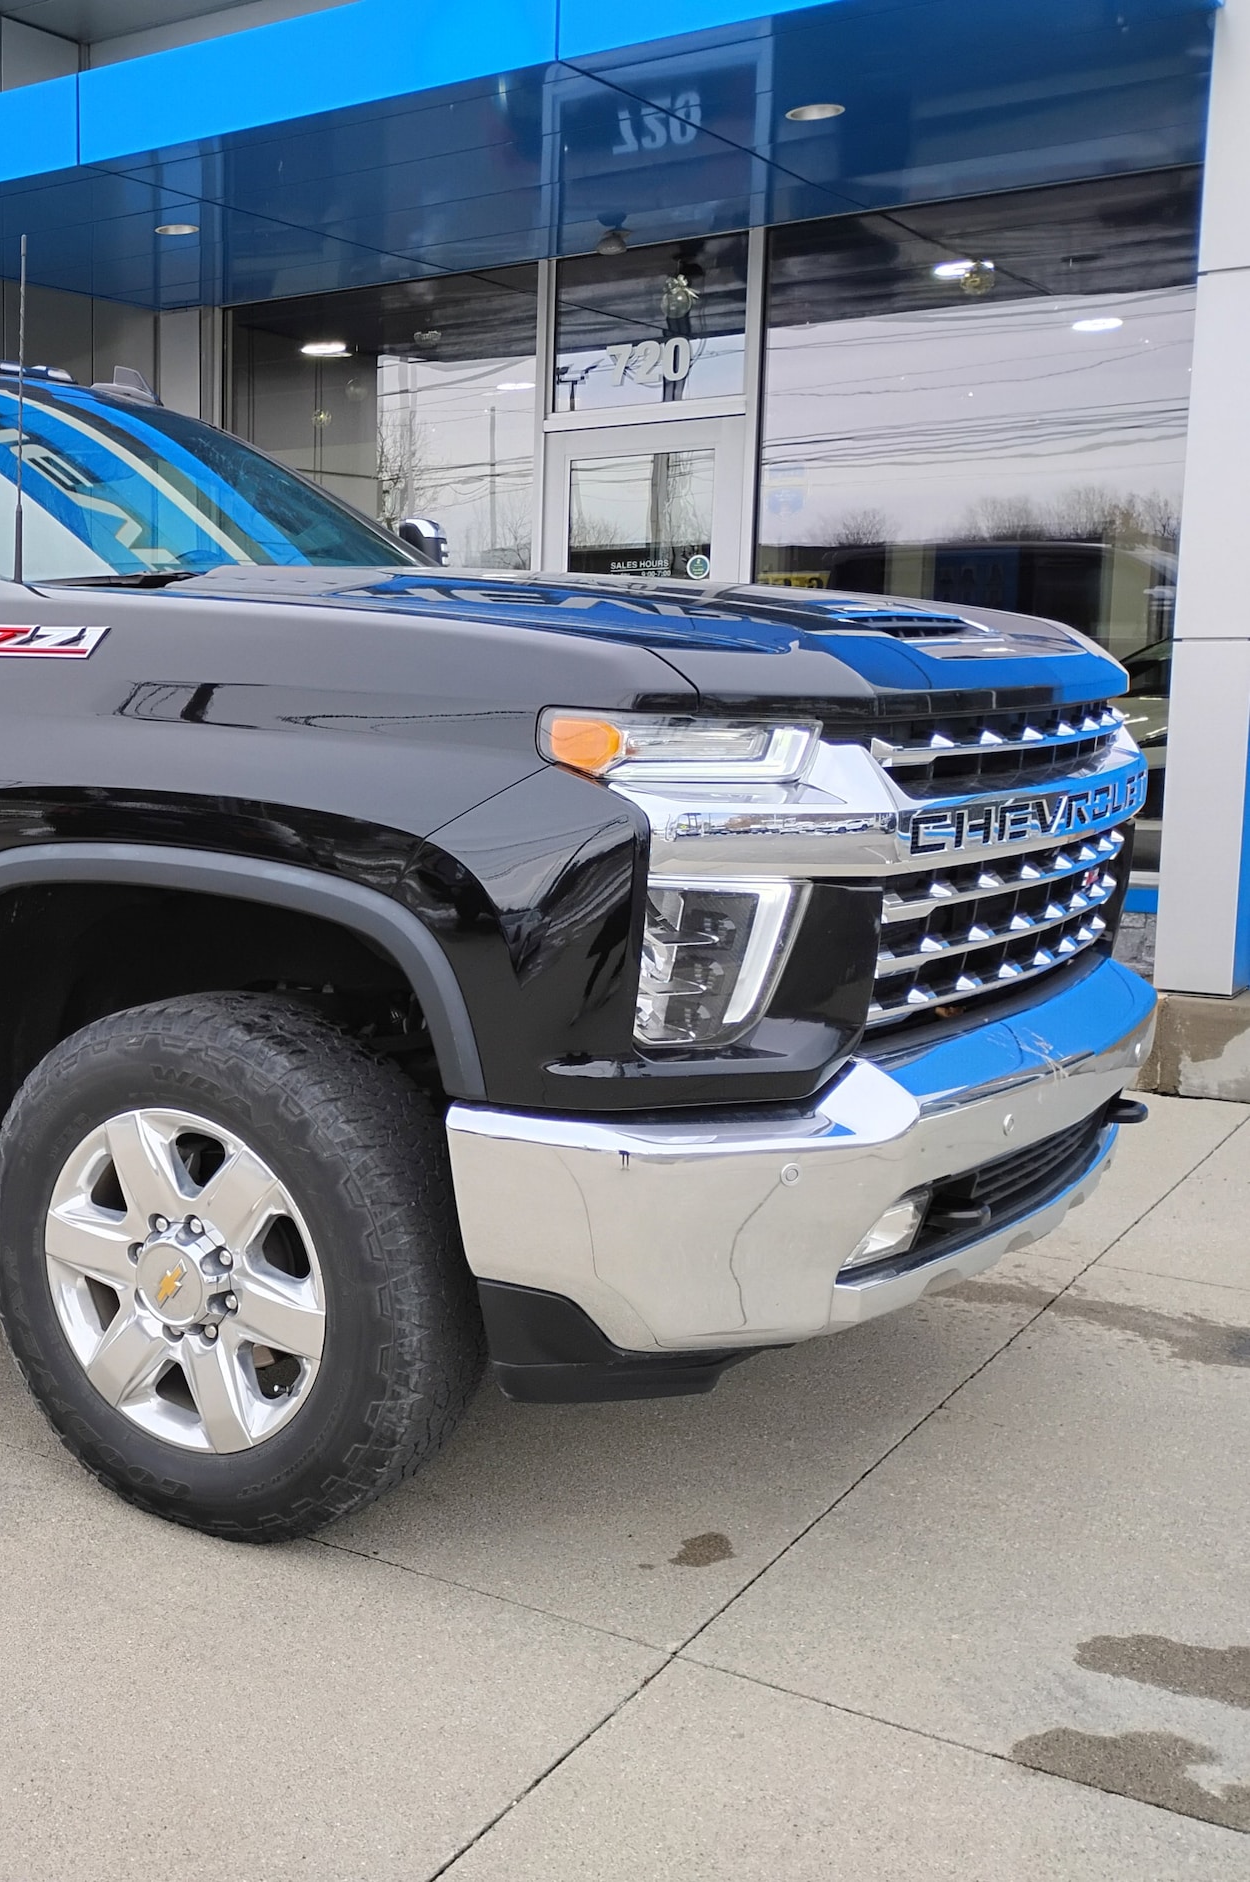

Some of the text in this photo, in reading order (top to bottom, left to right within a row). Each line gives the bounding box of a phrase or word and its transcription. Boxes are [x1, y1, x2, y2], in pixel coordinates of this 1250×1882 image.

[606, 336, 690, 386] 720
[610, 559, 670, 570] SALES HOURS
[910, 769, 1148, 857] CHEVROLET
